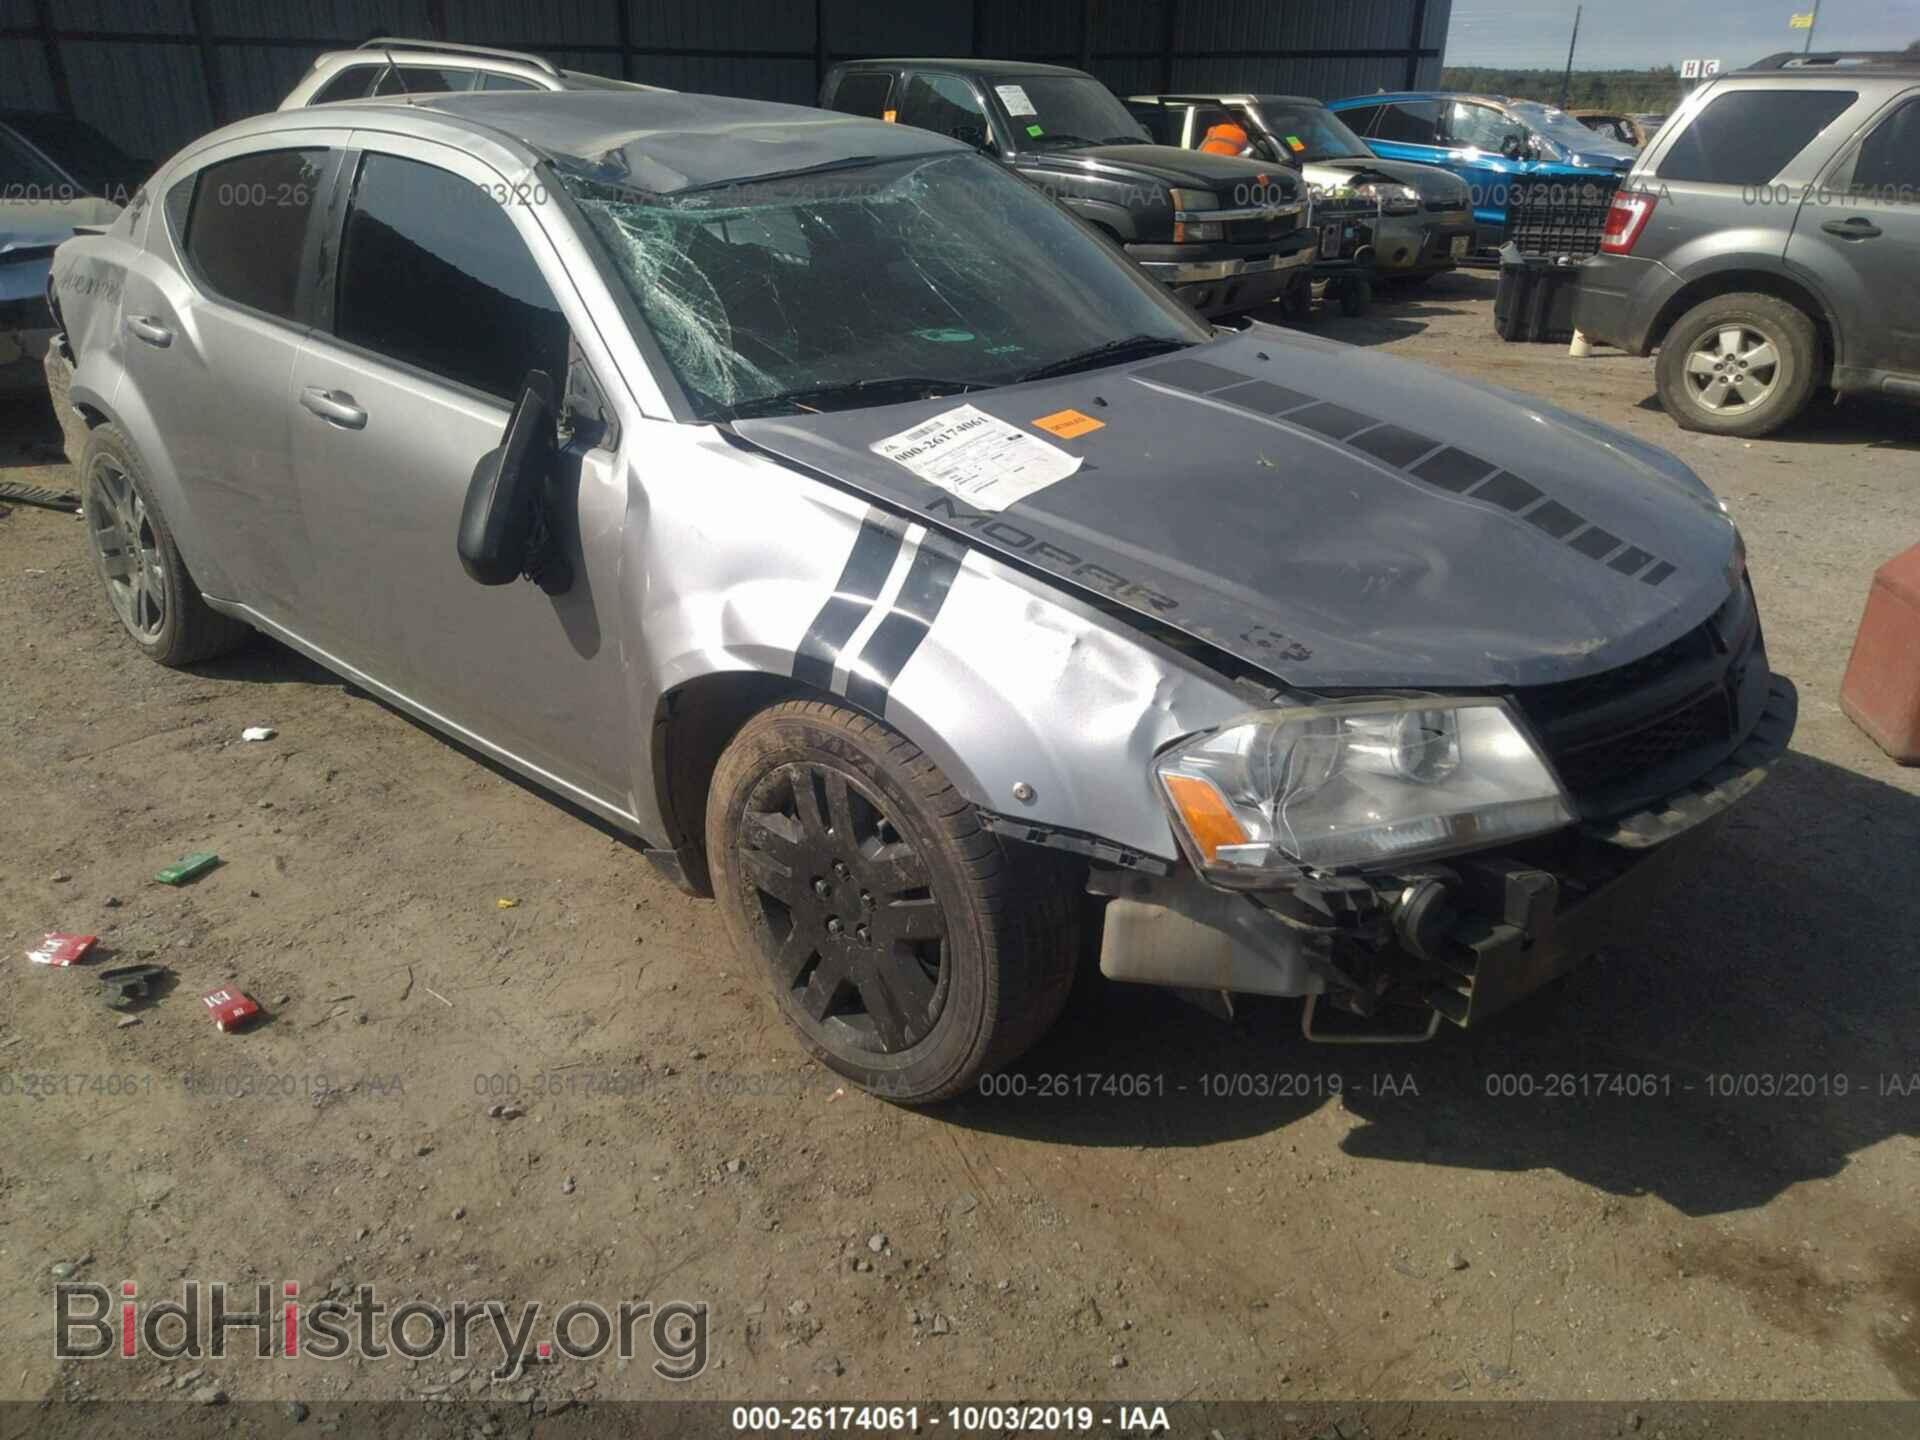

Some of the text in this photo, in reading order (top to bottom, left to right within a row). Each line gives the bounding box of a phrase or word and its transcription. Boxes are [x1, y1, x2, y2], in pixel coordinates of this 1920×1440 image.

[1685, 62, 1696, 76] H
[1705, 62, 1715, 76] G
[925, 496, 1179, 612] MOPAR
